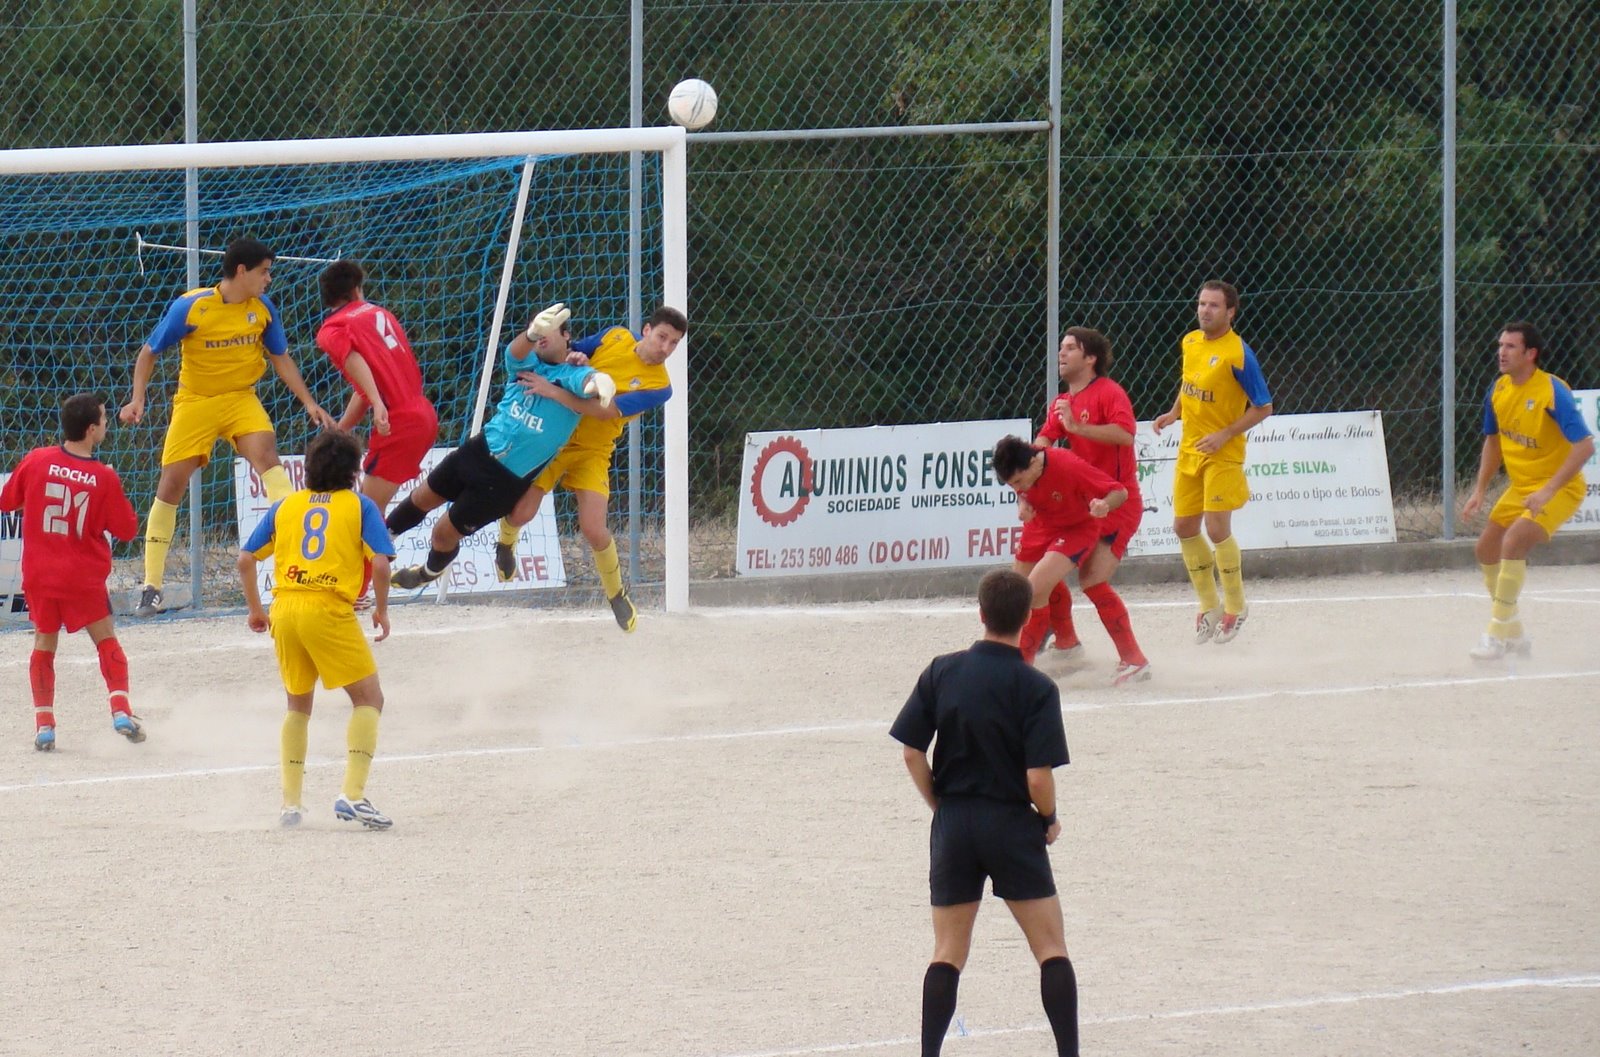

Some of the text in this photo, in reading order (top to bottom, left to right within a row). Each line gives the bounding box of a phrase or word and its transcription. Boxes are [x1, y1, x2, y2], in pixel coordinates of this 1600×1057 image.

[1289, 425, 1341, 441] Carvalho
[1343, 423, 1374, 439] Silva
[49, 464, 97, 487] ROCHA
[779, 450, 1006, 498] ALUMINIOS FONSE
[827, 490, 1019, 514] SOCIEDADE UNIPESSOAL, LD
[1266, 491, 1274, 501] e
[1275, 487, 1300, 501] todo
[1303, 490, 1310, 499] o
[1312, 487, 1332, 501] tipo
[1335, 487, 1348, 499] de
[43, 482, 90, 540] 21
[302, 506, 330, 561] 8
[747, 549, 777, 569] TEL:
[780, 548, 804, 568] 253
[808, 547, 831, 567] 590
[835, 545, 858, 565] 486
[868, 535, 950, 565] (DOCIM)
